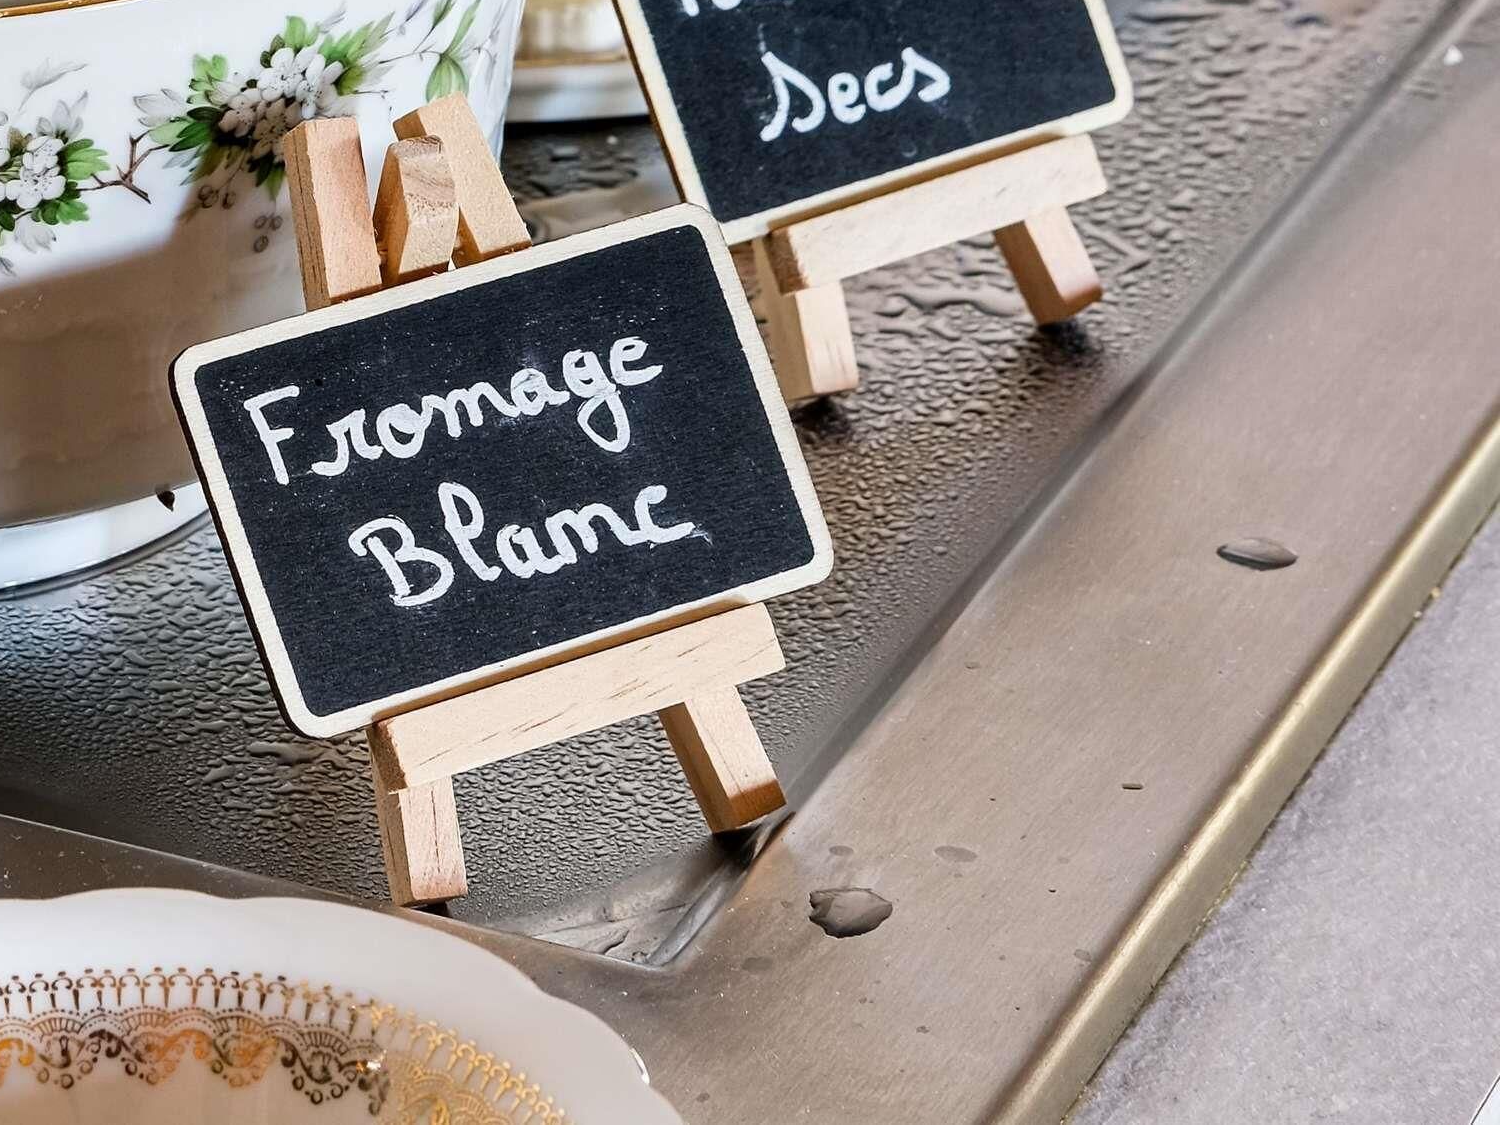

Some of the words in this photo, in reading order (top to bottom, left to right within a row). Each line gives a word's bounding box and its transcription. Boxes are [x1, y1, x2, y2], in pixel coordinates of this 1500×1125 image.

[760, 47, 951, 142] Secs
[242, 335, 664, 486] Fromage
[347, 481, 696, 608] Blanc
